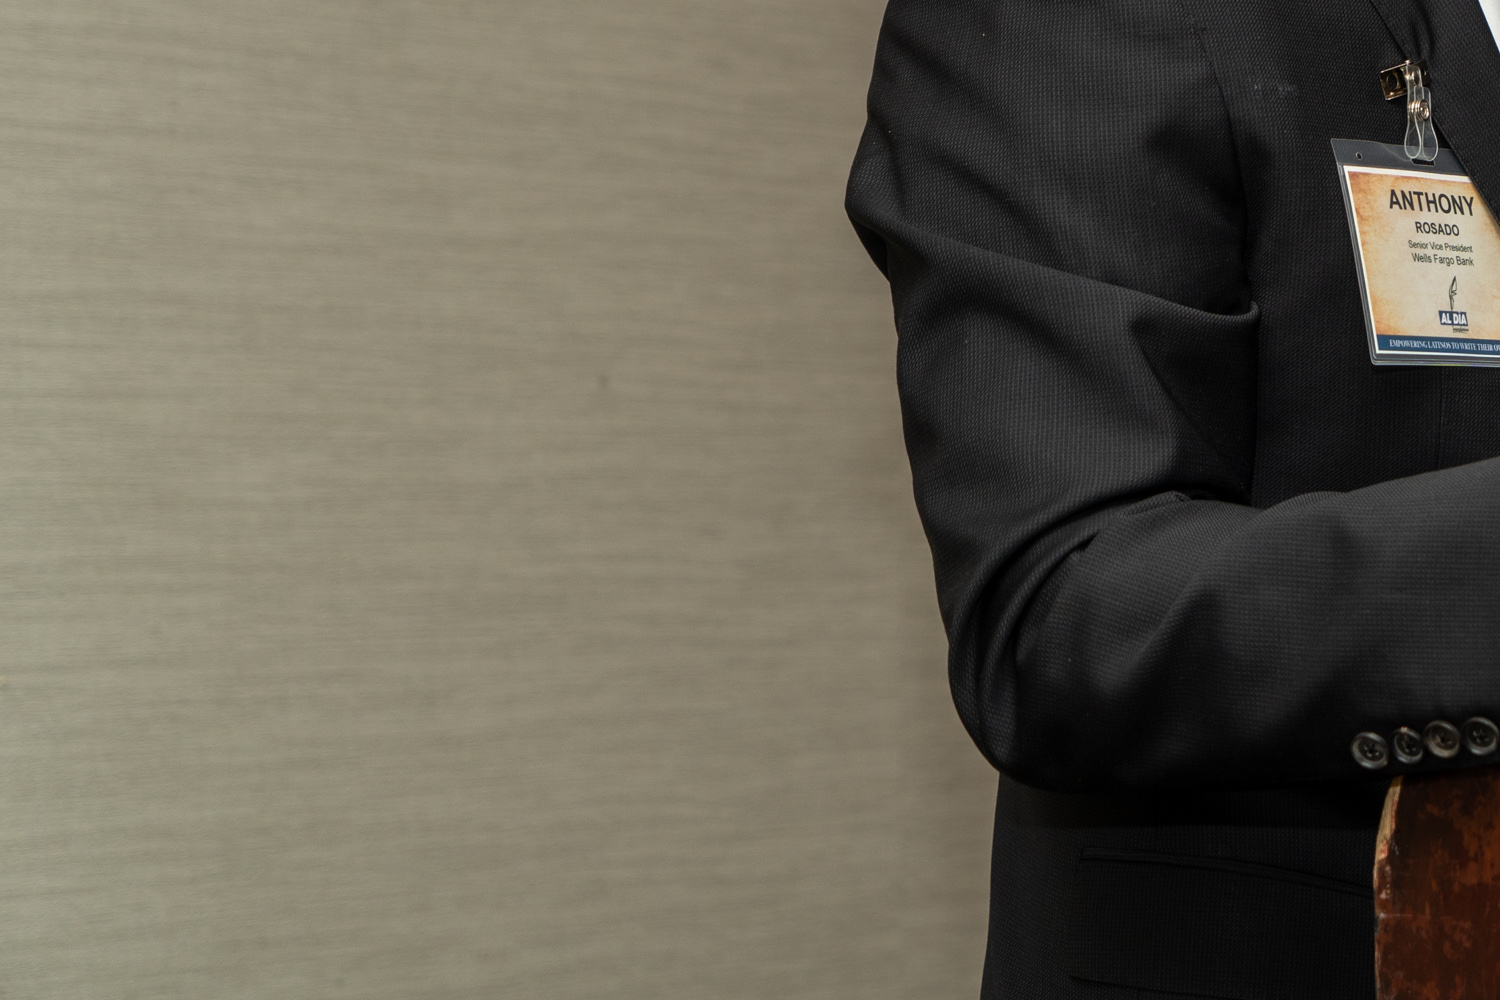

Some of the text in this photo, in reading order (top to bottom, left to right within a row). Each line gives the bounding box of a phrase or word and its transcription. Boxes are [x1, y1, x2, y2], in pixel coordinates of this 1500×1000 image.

[1389, 189, 1474, 216] ANTHONY
[1415, 221, 1460, 236] ROSADO
[1408, 239, 1473, 253] Senior Vice President
[1411, 252, 1474, 266] Wells Fargo Bank
[1441, 312, 1452, 324] AL
[1389, 339, 1427, 348] EMPOWERING
[1428, 340, 1451, 349] LATINOS
[1451, 342, 1459, 350] TO
[1459, 342, 1477, 350] WRITE
[1477, 343, 1493, 351] THEIR
